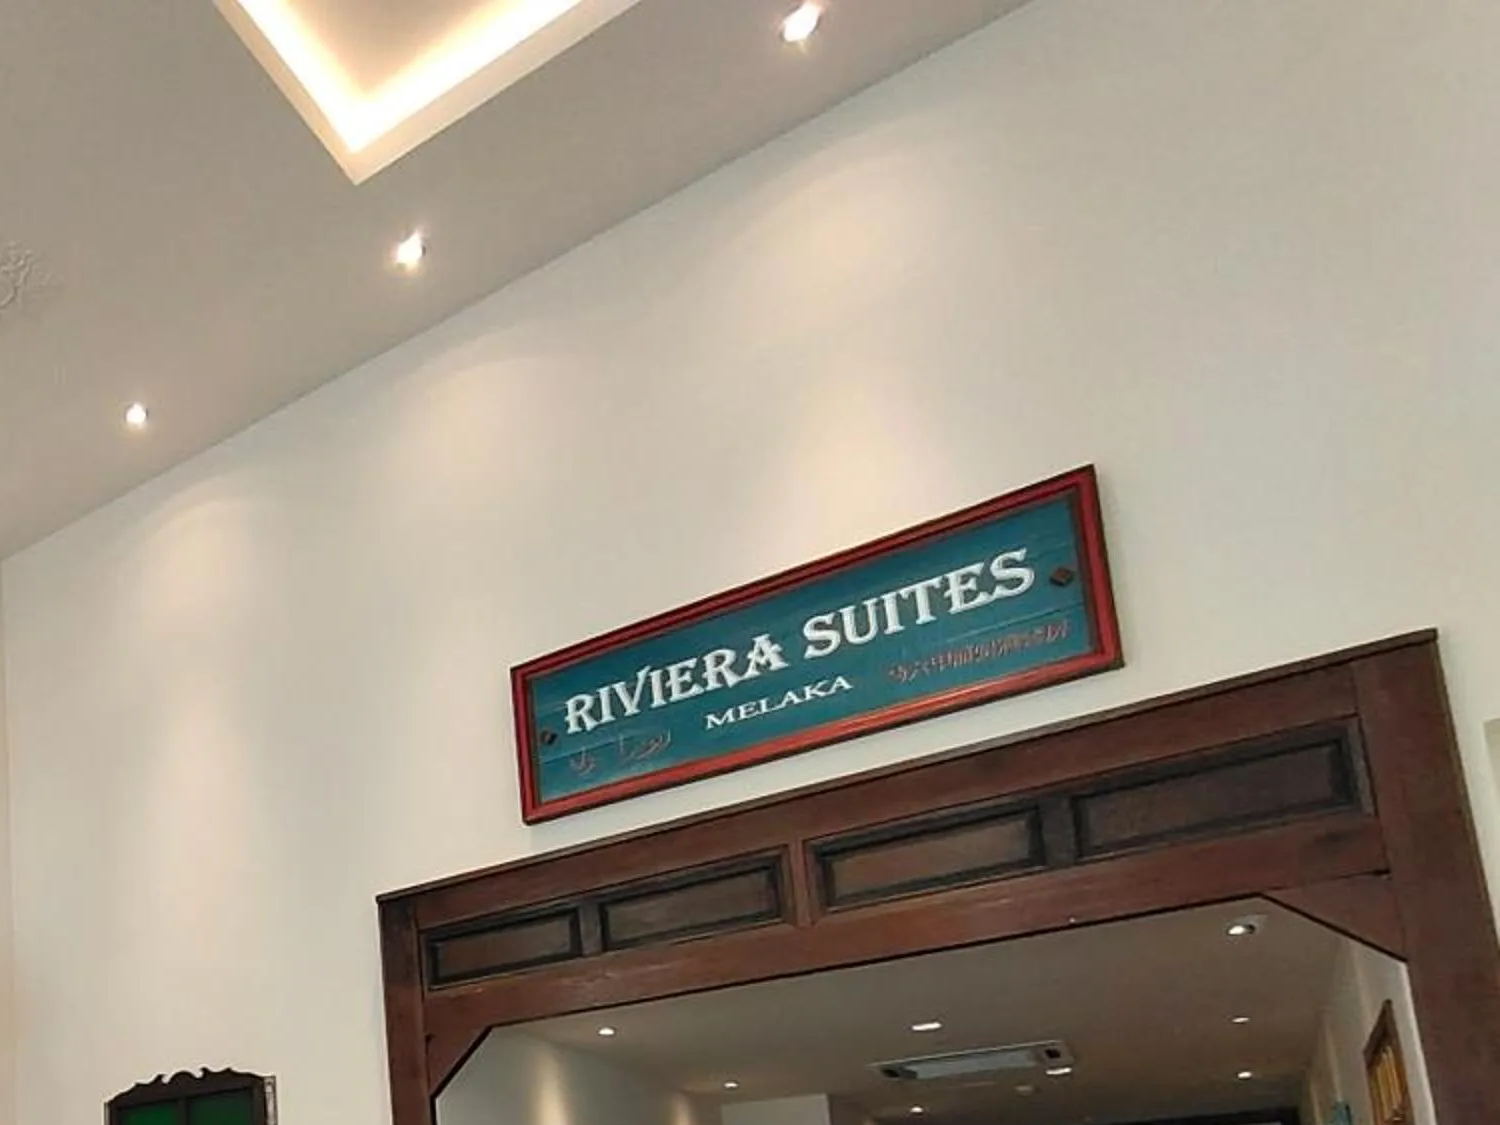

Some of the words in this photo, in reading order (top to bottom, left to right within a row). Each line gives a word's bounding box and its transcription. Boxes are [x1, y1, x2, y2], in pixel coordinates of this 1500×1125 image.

[564, 632, 789, 735] RIVIERA
[803, 547, 1036, 661] SUITES
[705, 675, 853, 732] MELAKA
